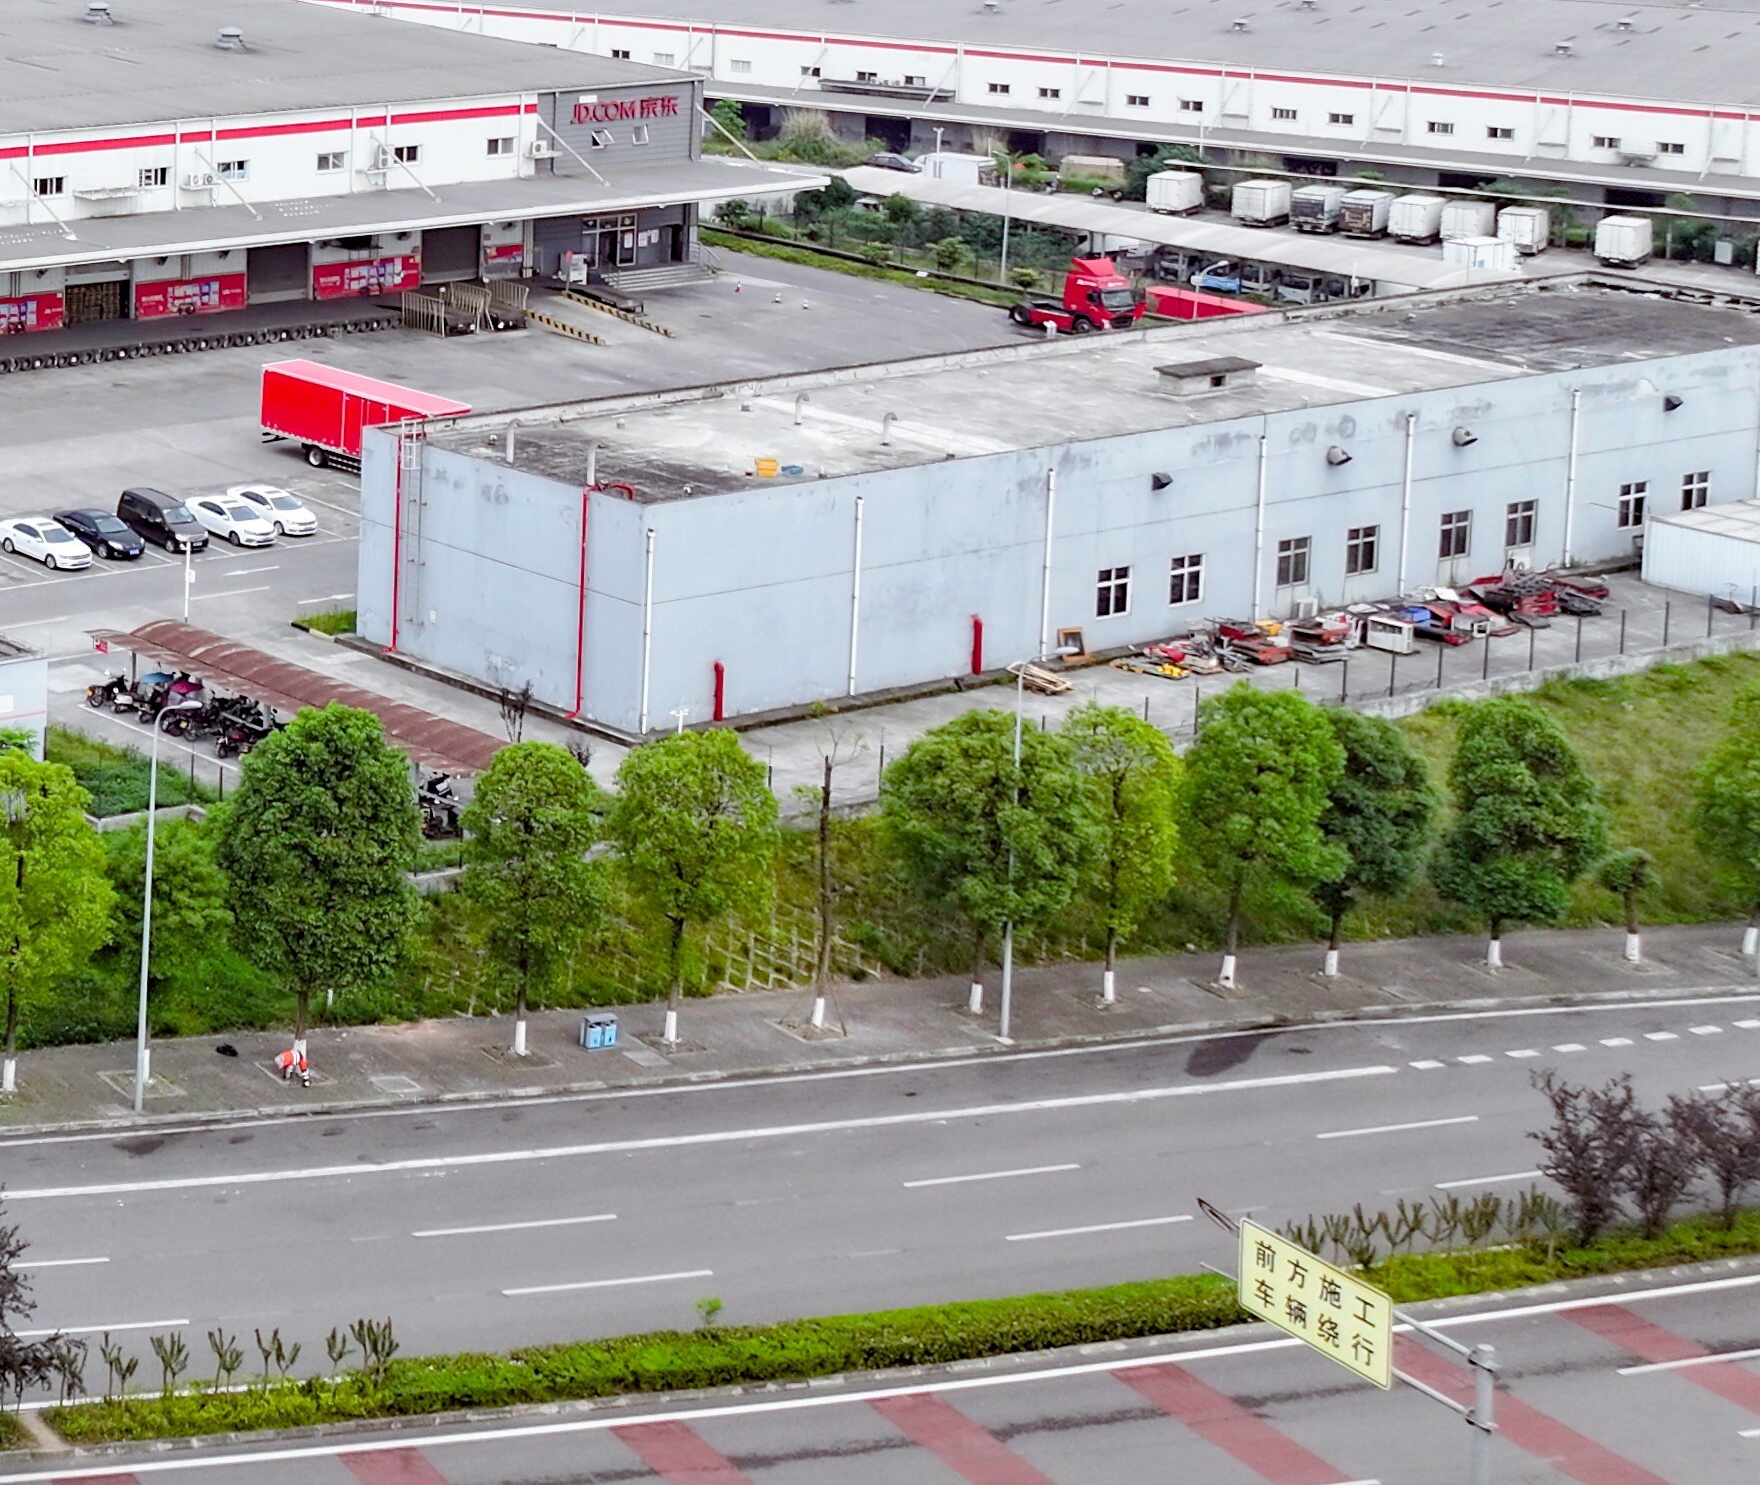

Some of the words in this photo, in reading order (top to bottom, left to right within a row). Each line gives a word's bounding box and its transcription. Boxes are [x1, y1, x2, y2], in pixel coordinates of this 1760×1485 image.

[1253, 1278, 1375, 1367] 车辆绕行
[1254, 1239, 1376, 1329] 前方施工
